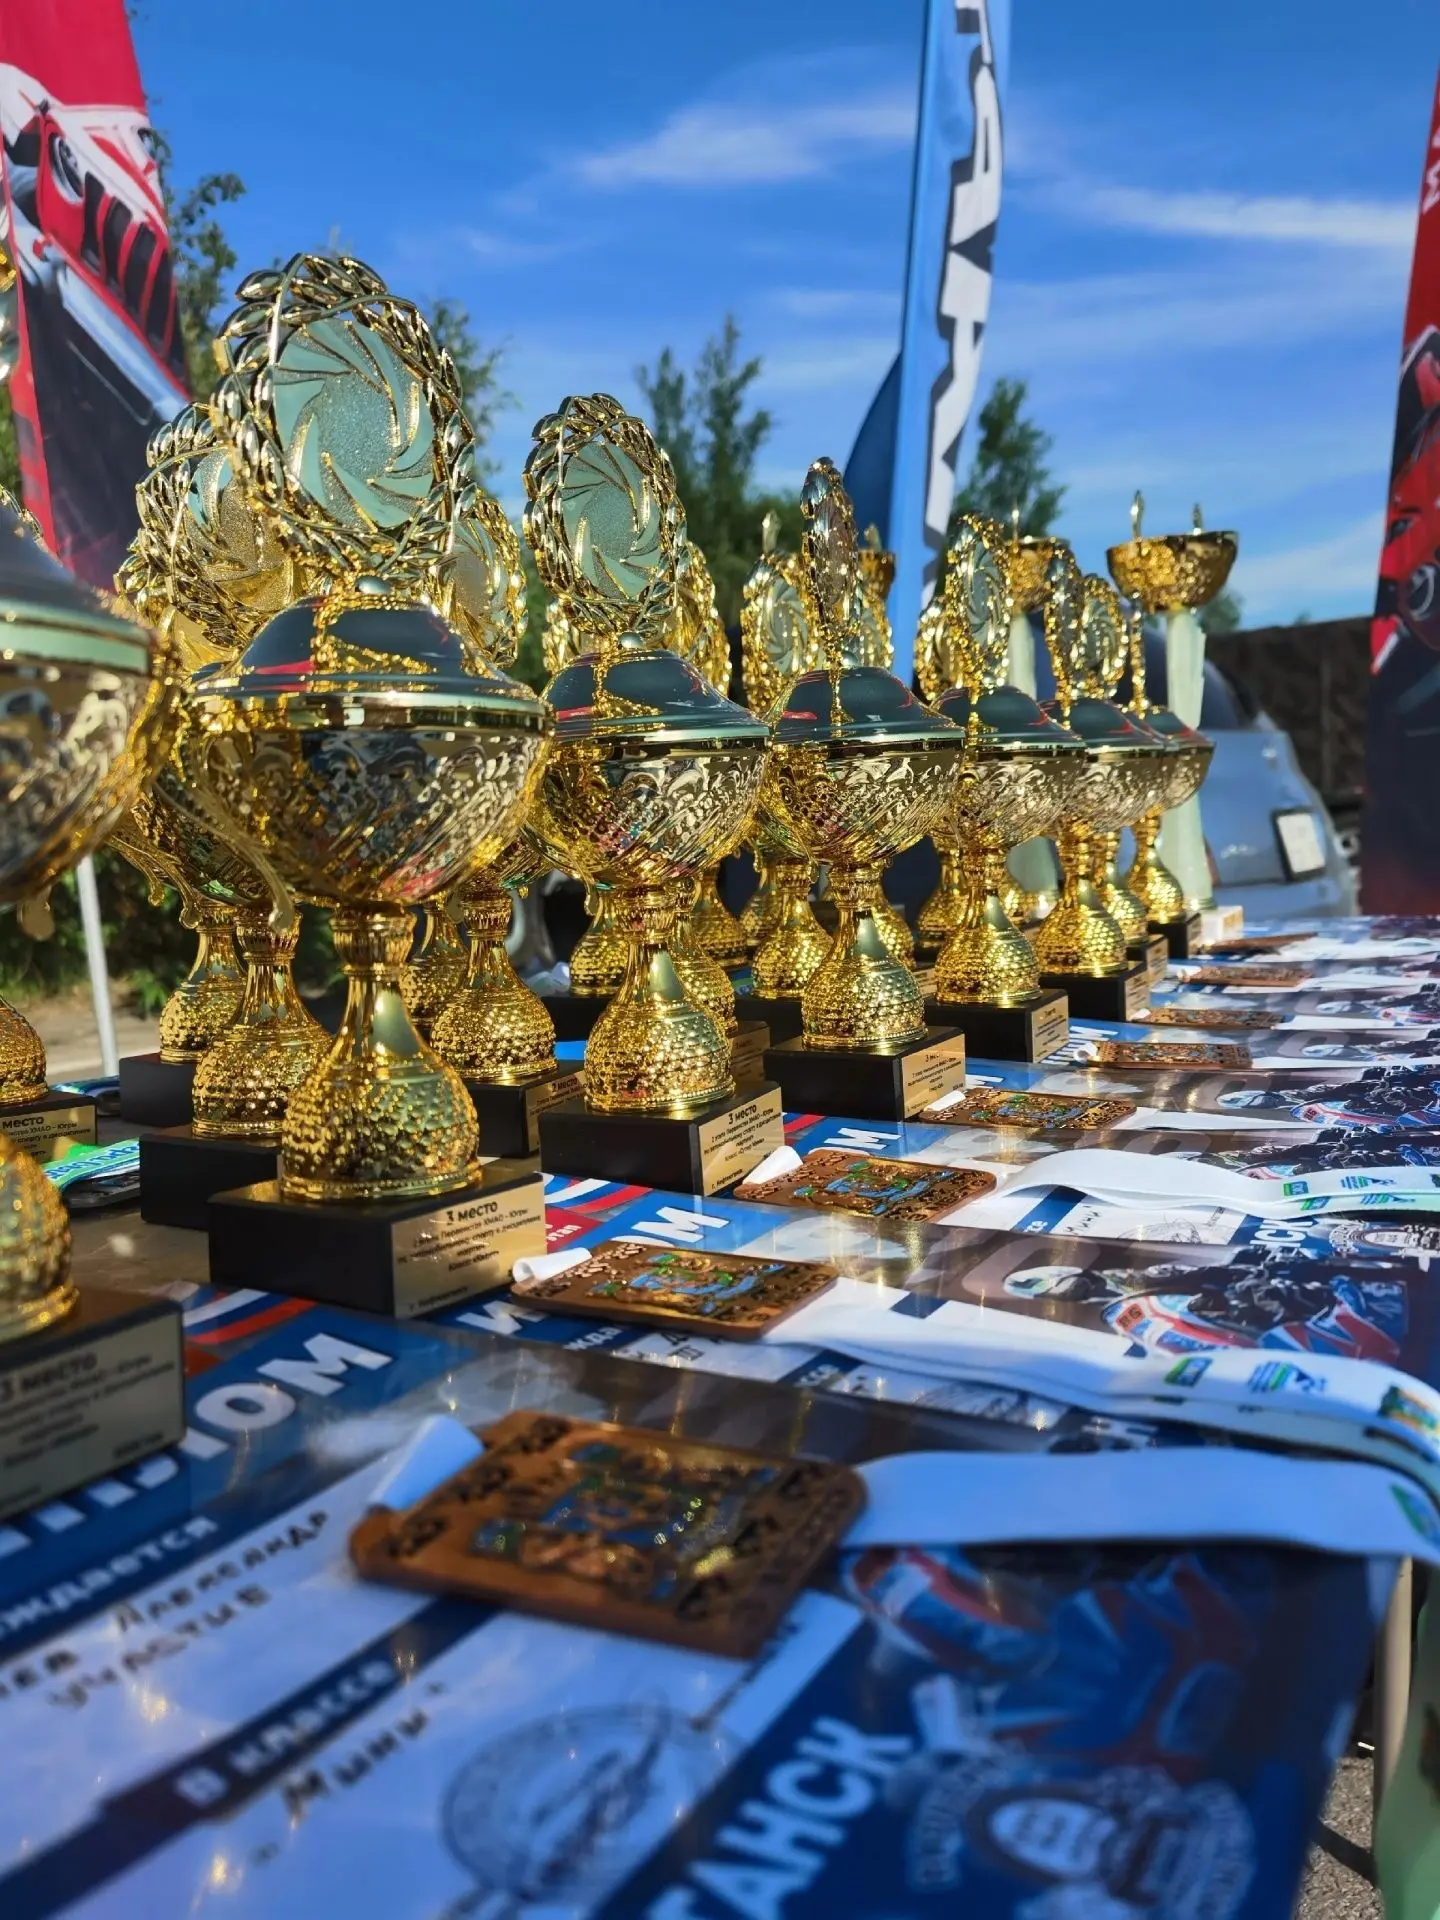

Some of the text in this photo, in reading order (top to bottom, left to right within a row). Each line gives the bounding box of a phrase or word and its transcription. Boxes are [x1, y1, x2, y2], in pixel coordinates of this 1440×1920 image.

[1, 1116, 45, 1130] место
[728, 1104, 758, 1125] 3 место
[457, 1201, 498, 1222] место
